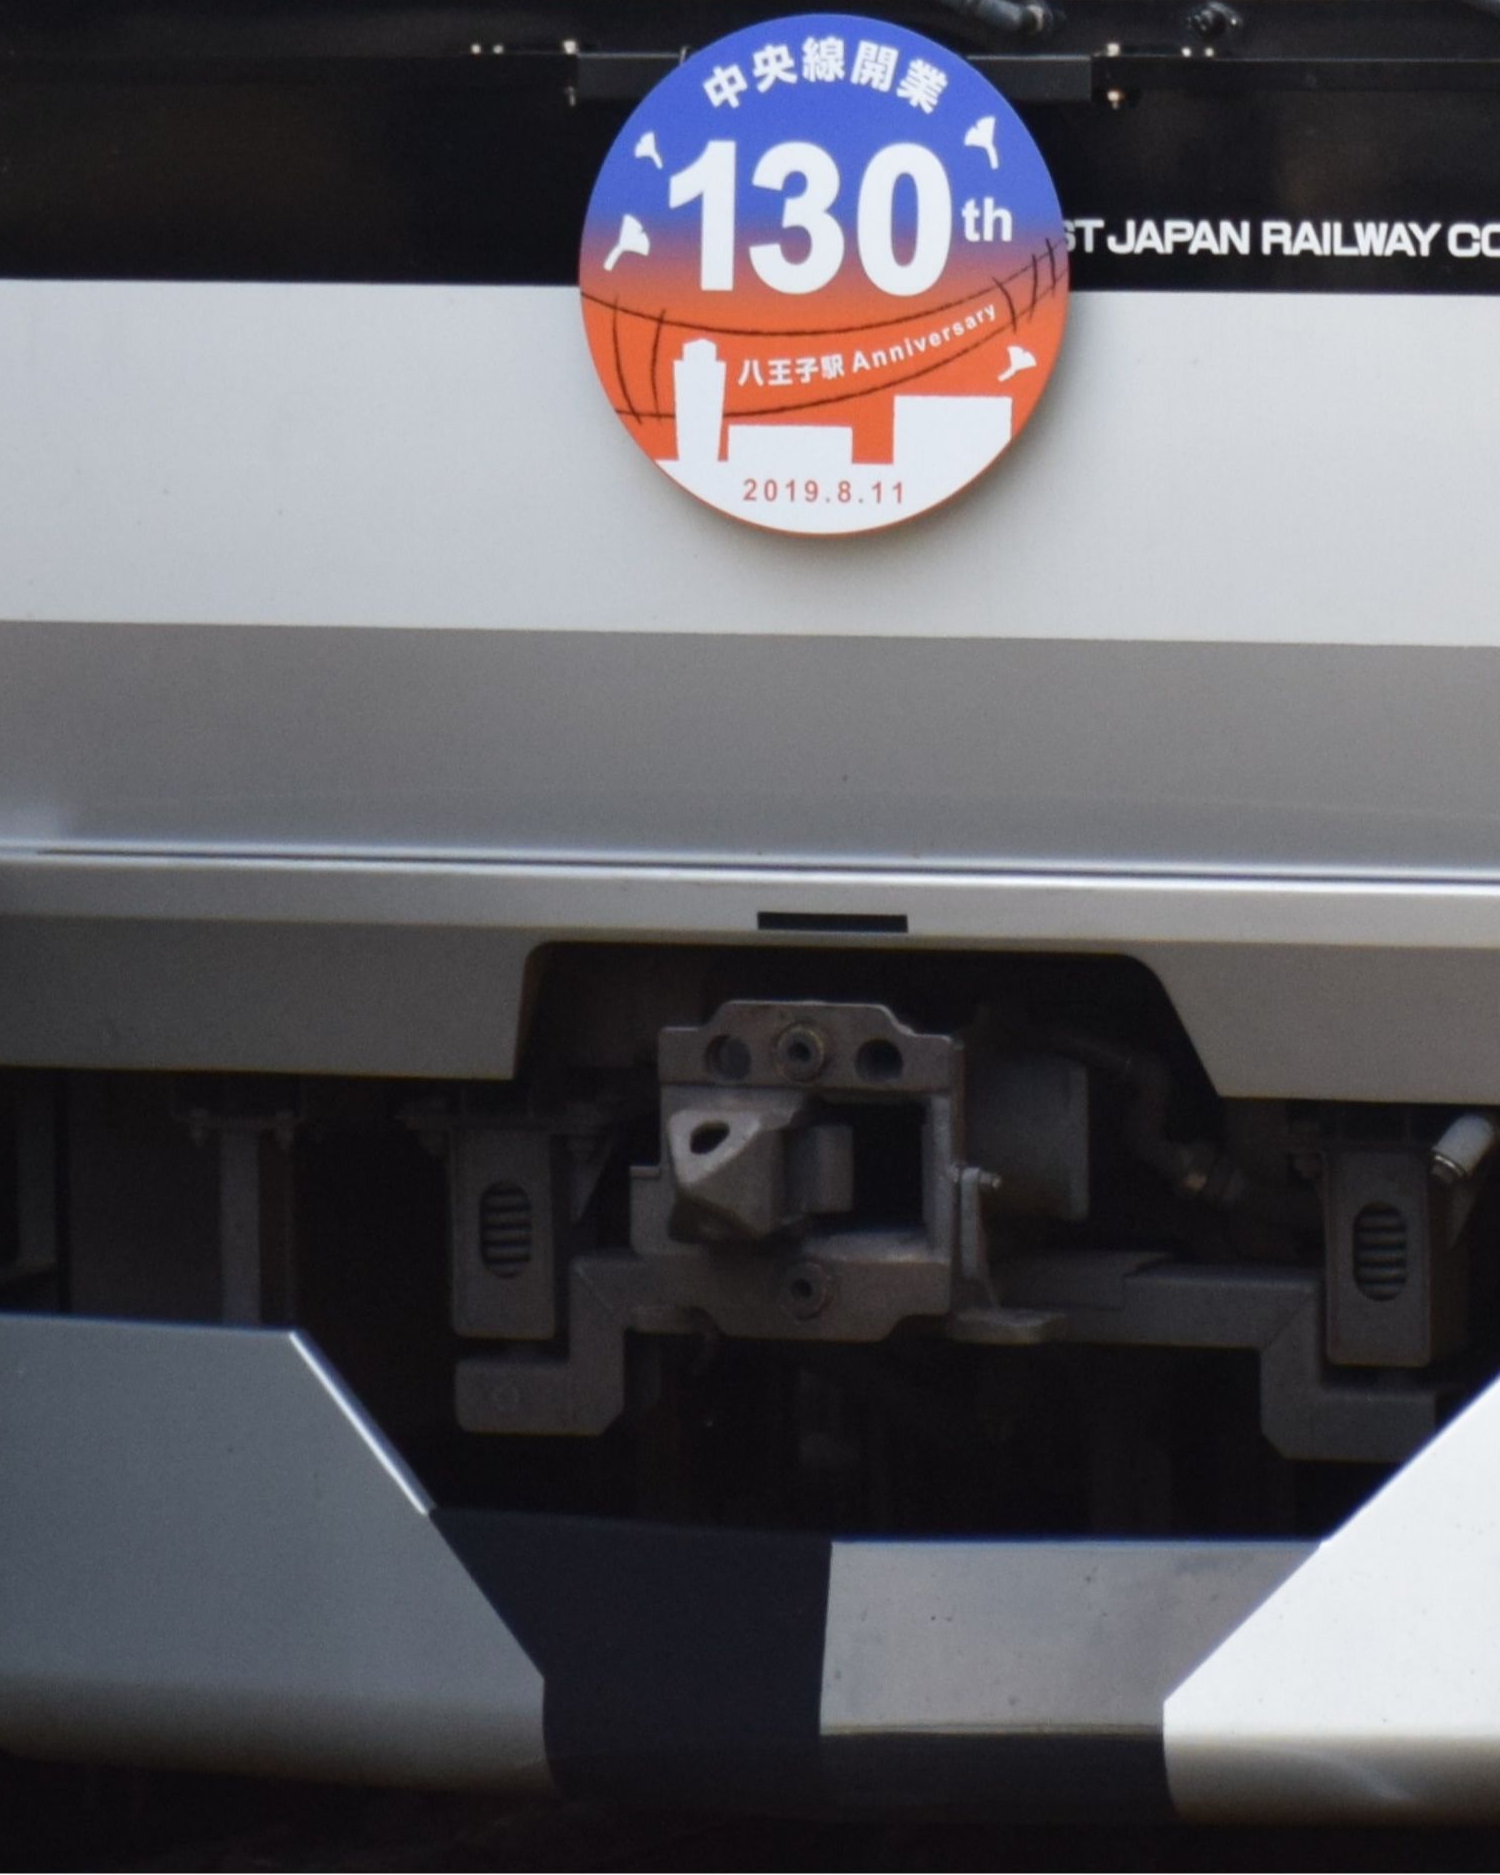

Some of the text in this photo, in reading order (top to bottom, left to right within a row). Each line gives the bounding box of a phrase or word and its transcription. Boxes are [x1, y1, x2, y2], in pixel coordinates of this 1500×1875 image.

[703, 36, 949, 115] 中央線開業
[1109, 219, 1250, 256] JAPAN
[1262, 221, 1438, 258] RAILWAY
[738, 302, 997, 387] 八王子駅 Anniversary
[743, 477, 905, 503] 2019.8.11
